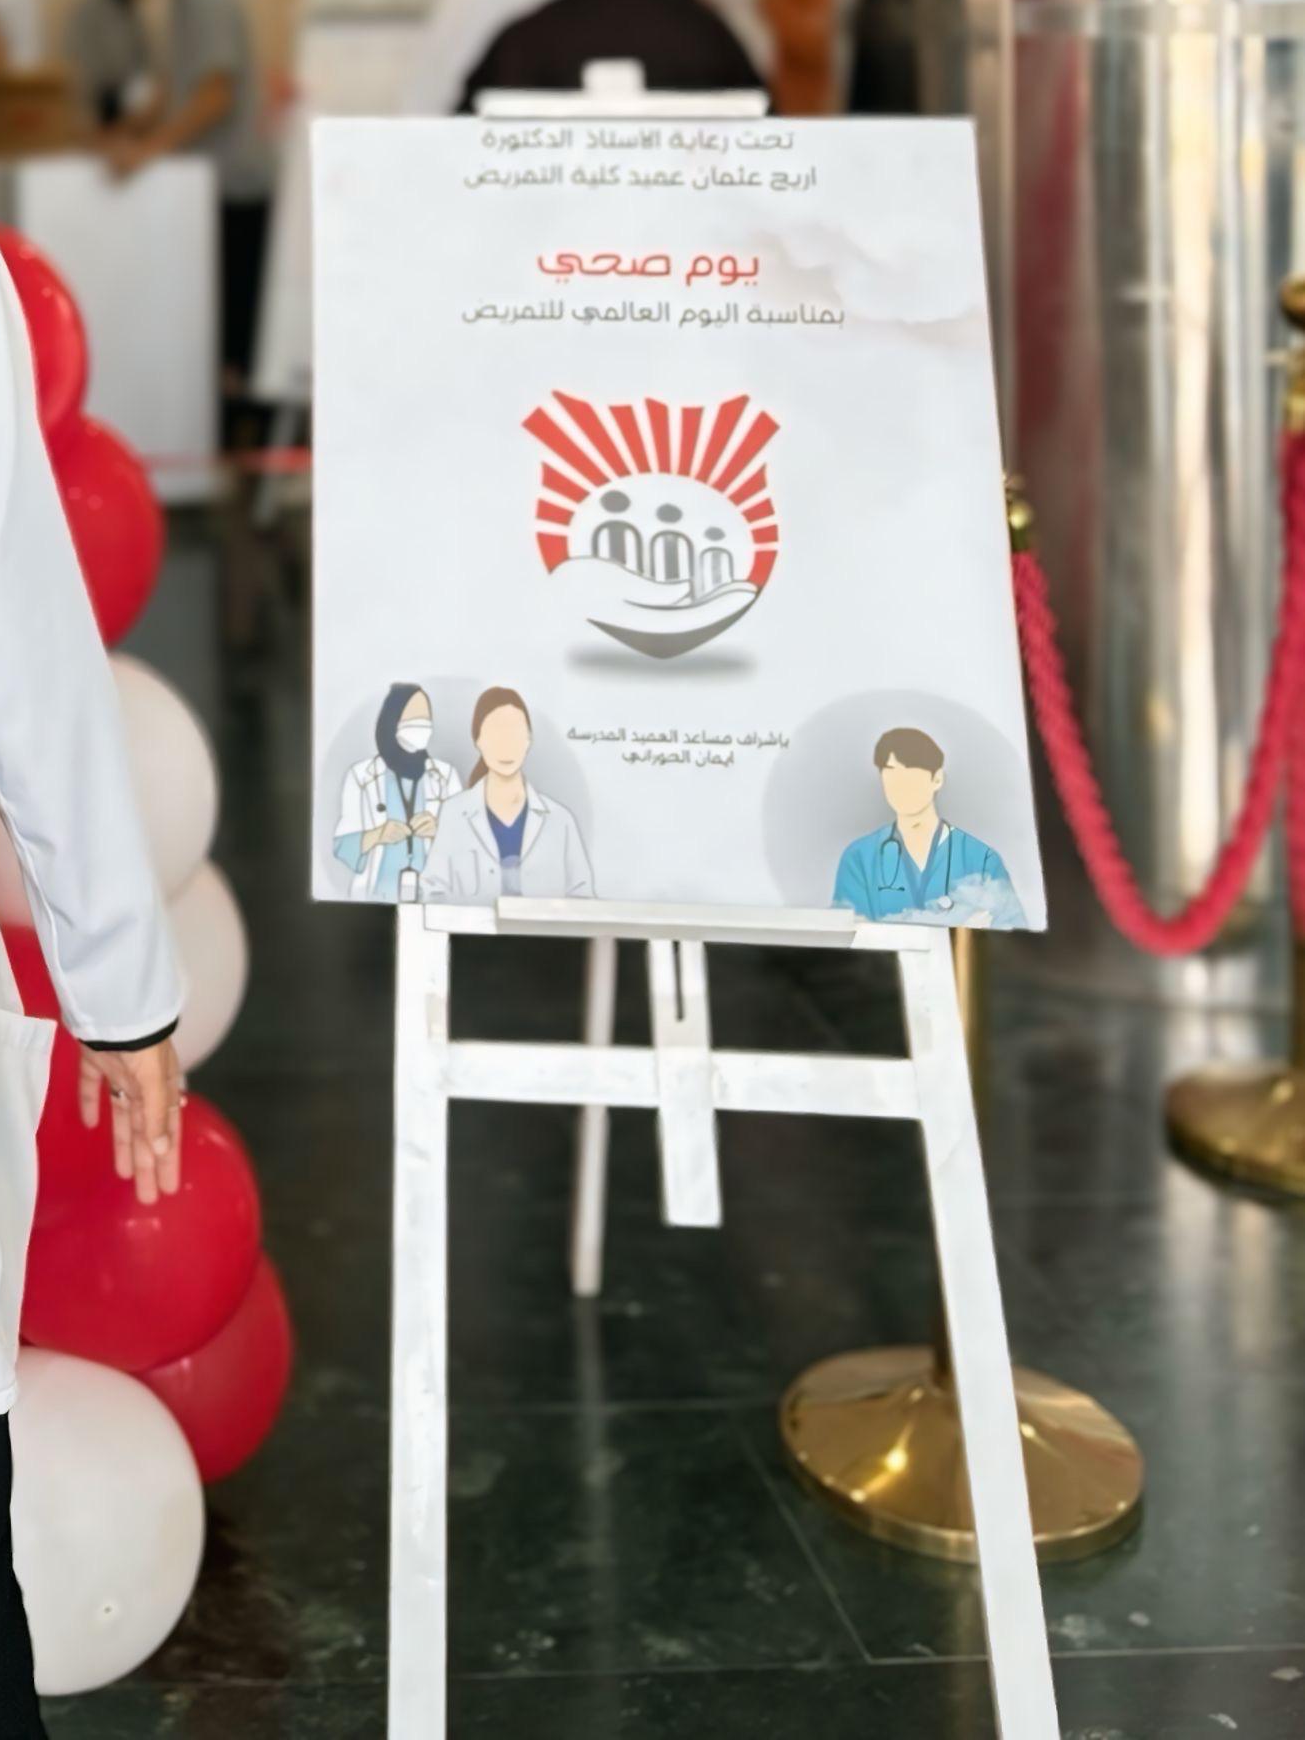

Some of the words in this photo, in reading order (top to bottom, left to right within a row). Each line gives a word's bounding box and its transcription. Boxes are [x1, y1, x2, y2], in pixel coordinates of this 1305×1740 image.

[481, 127, 573, 153] الدكتورة
[668, 128, 729, 154] رعاية
[735, 129, 795, 150] تحت
[463, 162, 564, 190] التمريض
[570, 163, 621, 189] كلية
[628, 167, 685, 190] عميد
[691, 164, 763, 191] عثمان
[537, 252, 672, 285] صحي
[685, 254, 759, 287] يوم
[461, 297, 564, 325] للتمريض
[571, 300, 670, 325] العالمي
[678, 301, 739, 329] اليوم
[746, 303, 845, 330] بمناسبة
